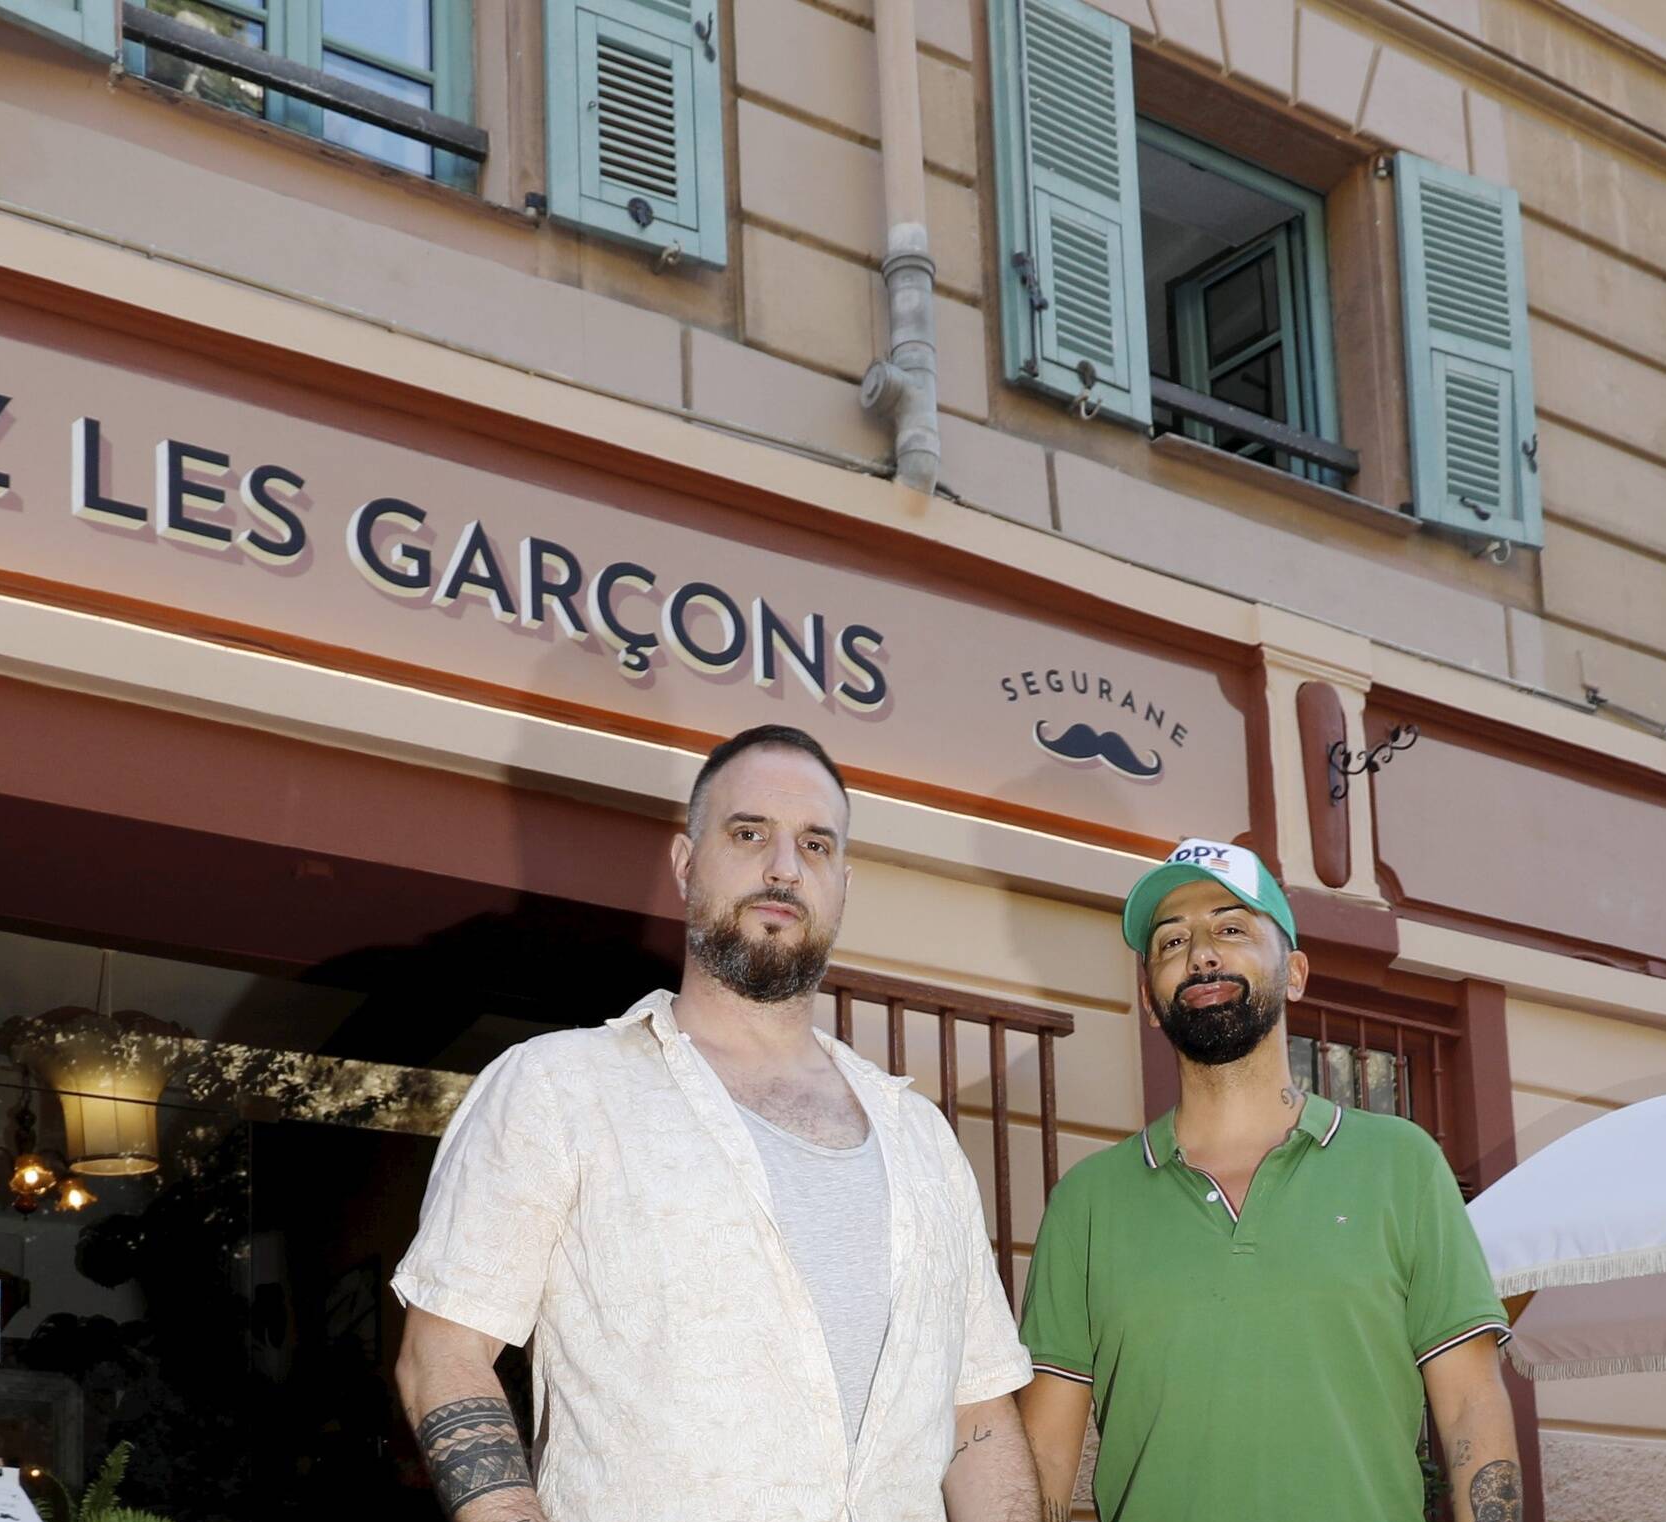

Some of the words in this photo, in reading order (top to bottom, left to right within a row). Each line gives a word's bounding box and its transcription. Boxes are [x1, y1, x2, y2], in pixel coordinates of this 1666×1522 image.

[70, 416, 309, 567] LES
[345, 496, 888, 712] GARÇONS
[1001, 669, 1188, 748] SEGURANE
